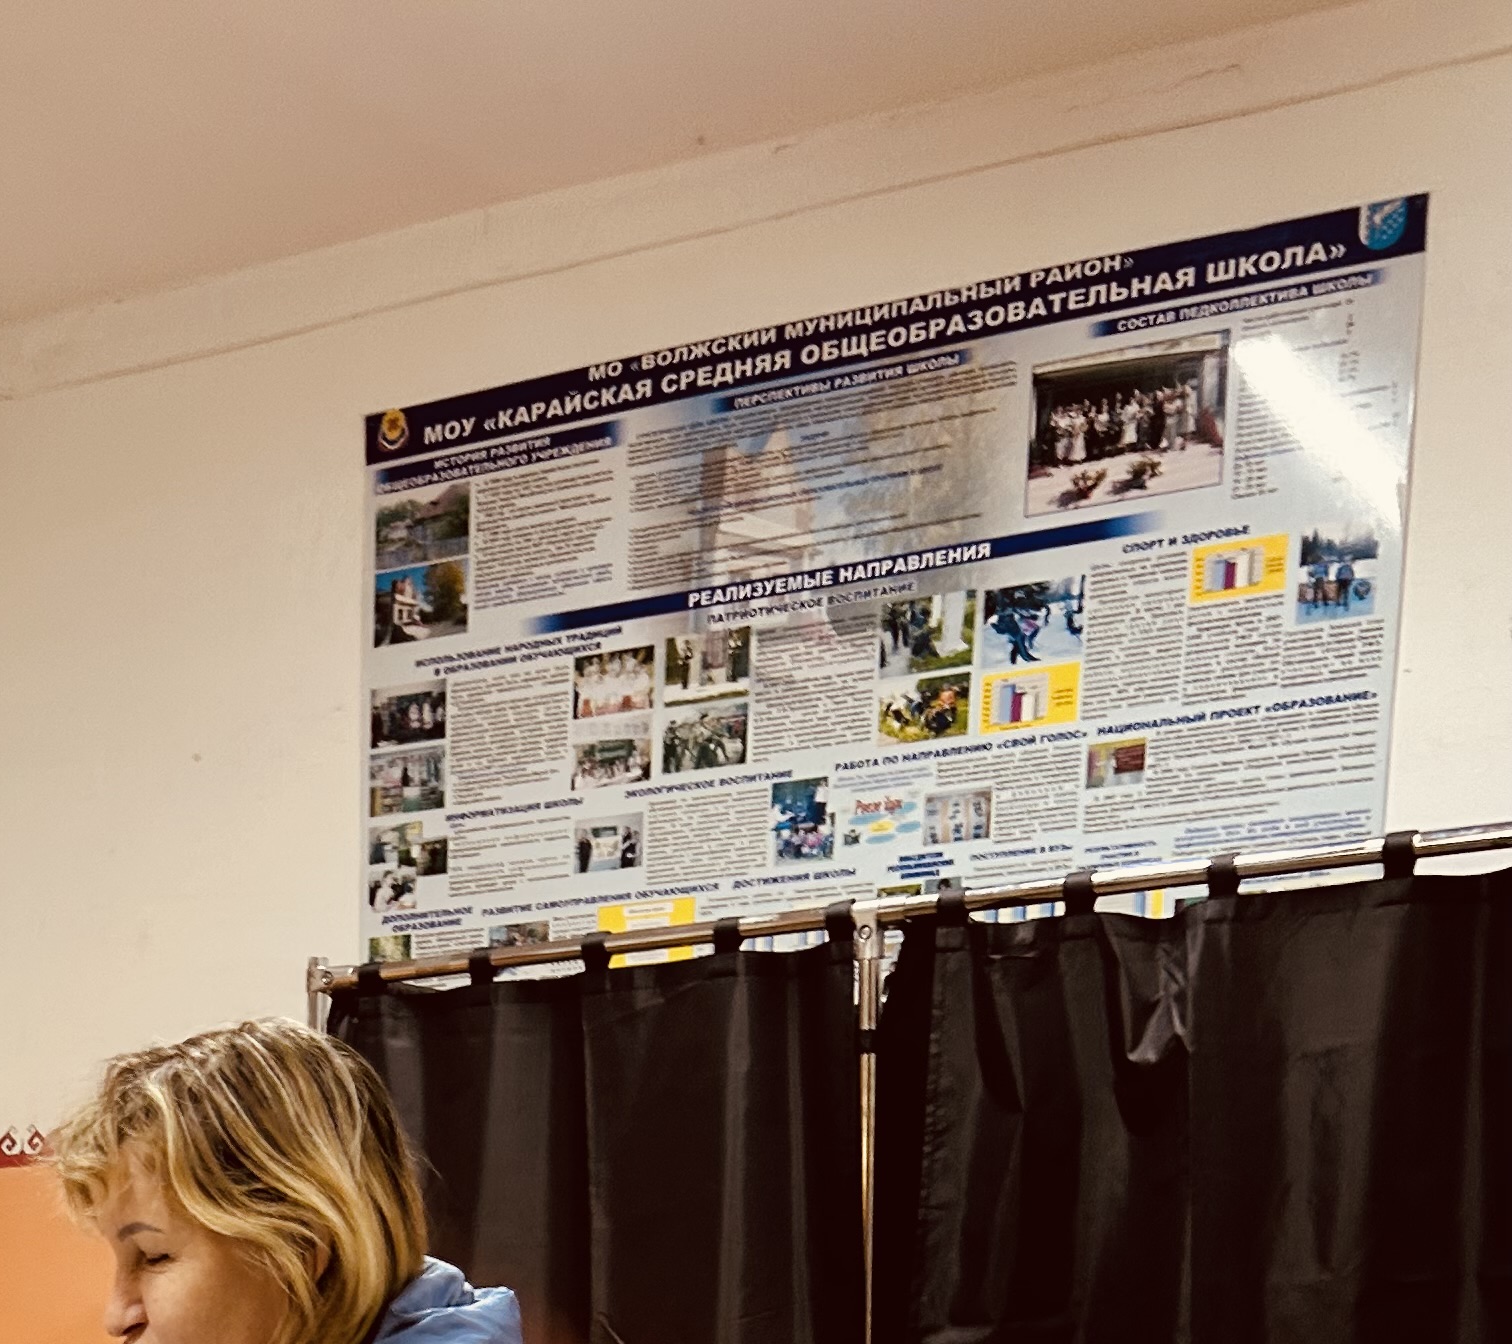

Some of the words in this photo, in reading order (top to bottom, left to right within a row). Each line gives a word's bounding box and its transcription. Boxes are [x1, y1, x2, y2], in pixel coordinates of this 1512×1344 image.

[423, 416, 476, 445] МОУ
[483, 379, 653, 432] «КАРАЙСКАЯ
[660, 349, 792, 394] СРЕДНЯЯ
[799, 265, 1196, 366] ОБЩЕОБРАЗОВАТЕЛЬНАЯ
[1205, 241, 1347, 284] ШКОЛА»
[1116, 311, 1176, 332] СОСТАВ
[588, 360, 623, 382] МО
[687, 569, 834, 610] РЕАЛИЗУЕМЫЕ
[839, 542, 992, 584] НАПРАВЛЕНИЯ
